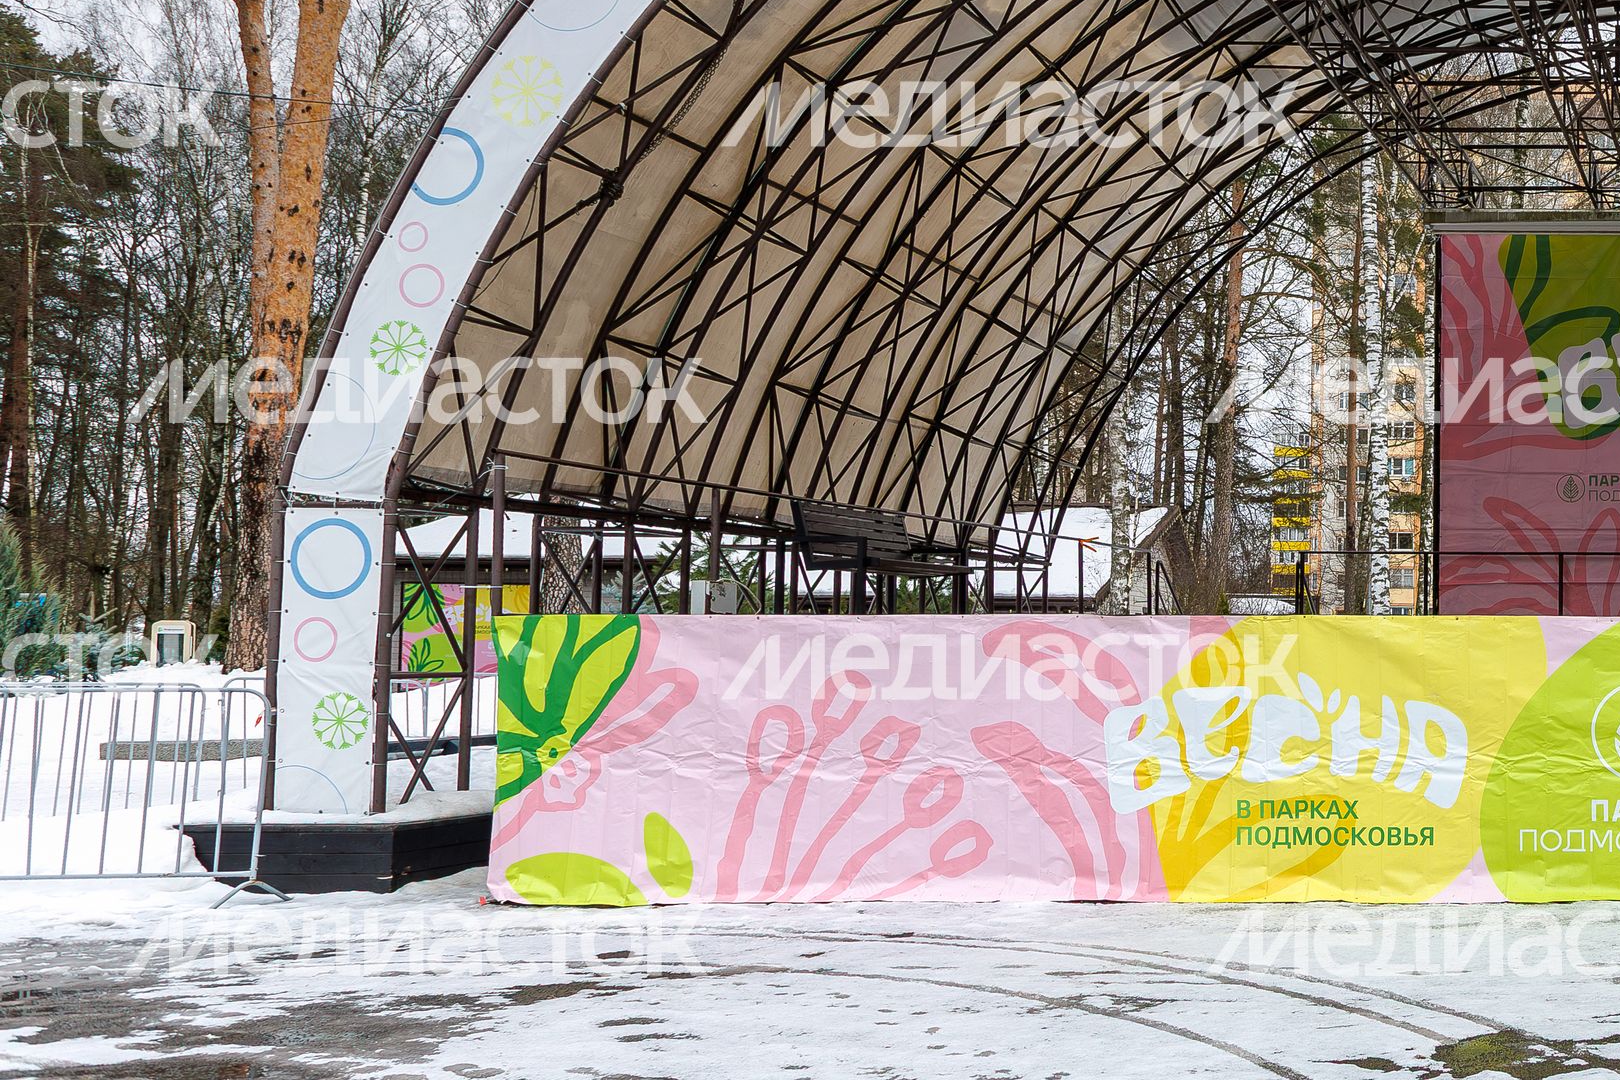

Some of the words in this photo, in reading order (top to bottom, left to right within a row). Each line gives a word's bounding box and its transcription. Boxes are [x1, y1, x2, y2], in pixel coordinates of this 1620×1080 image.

[1236, 799, 1251, 819] В
[1259, 799, 1359, 820] ПАРКАХ
[1236, 825, 1435, 849] ПОДМОСКОВЬЯ
